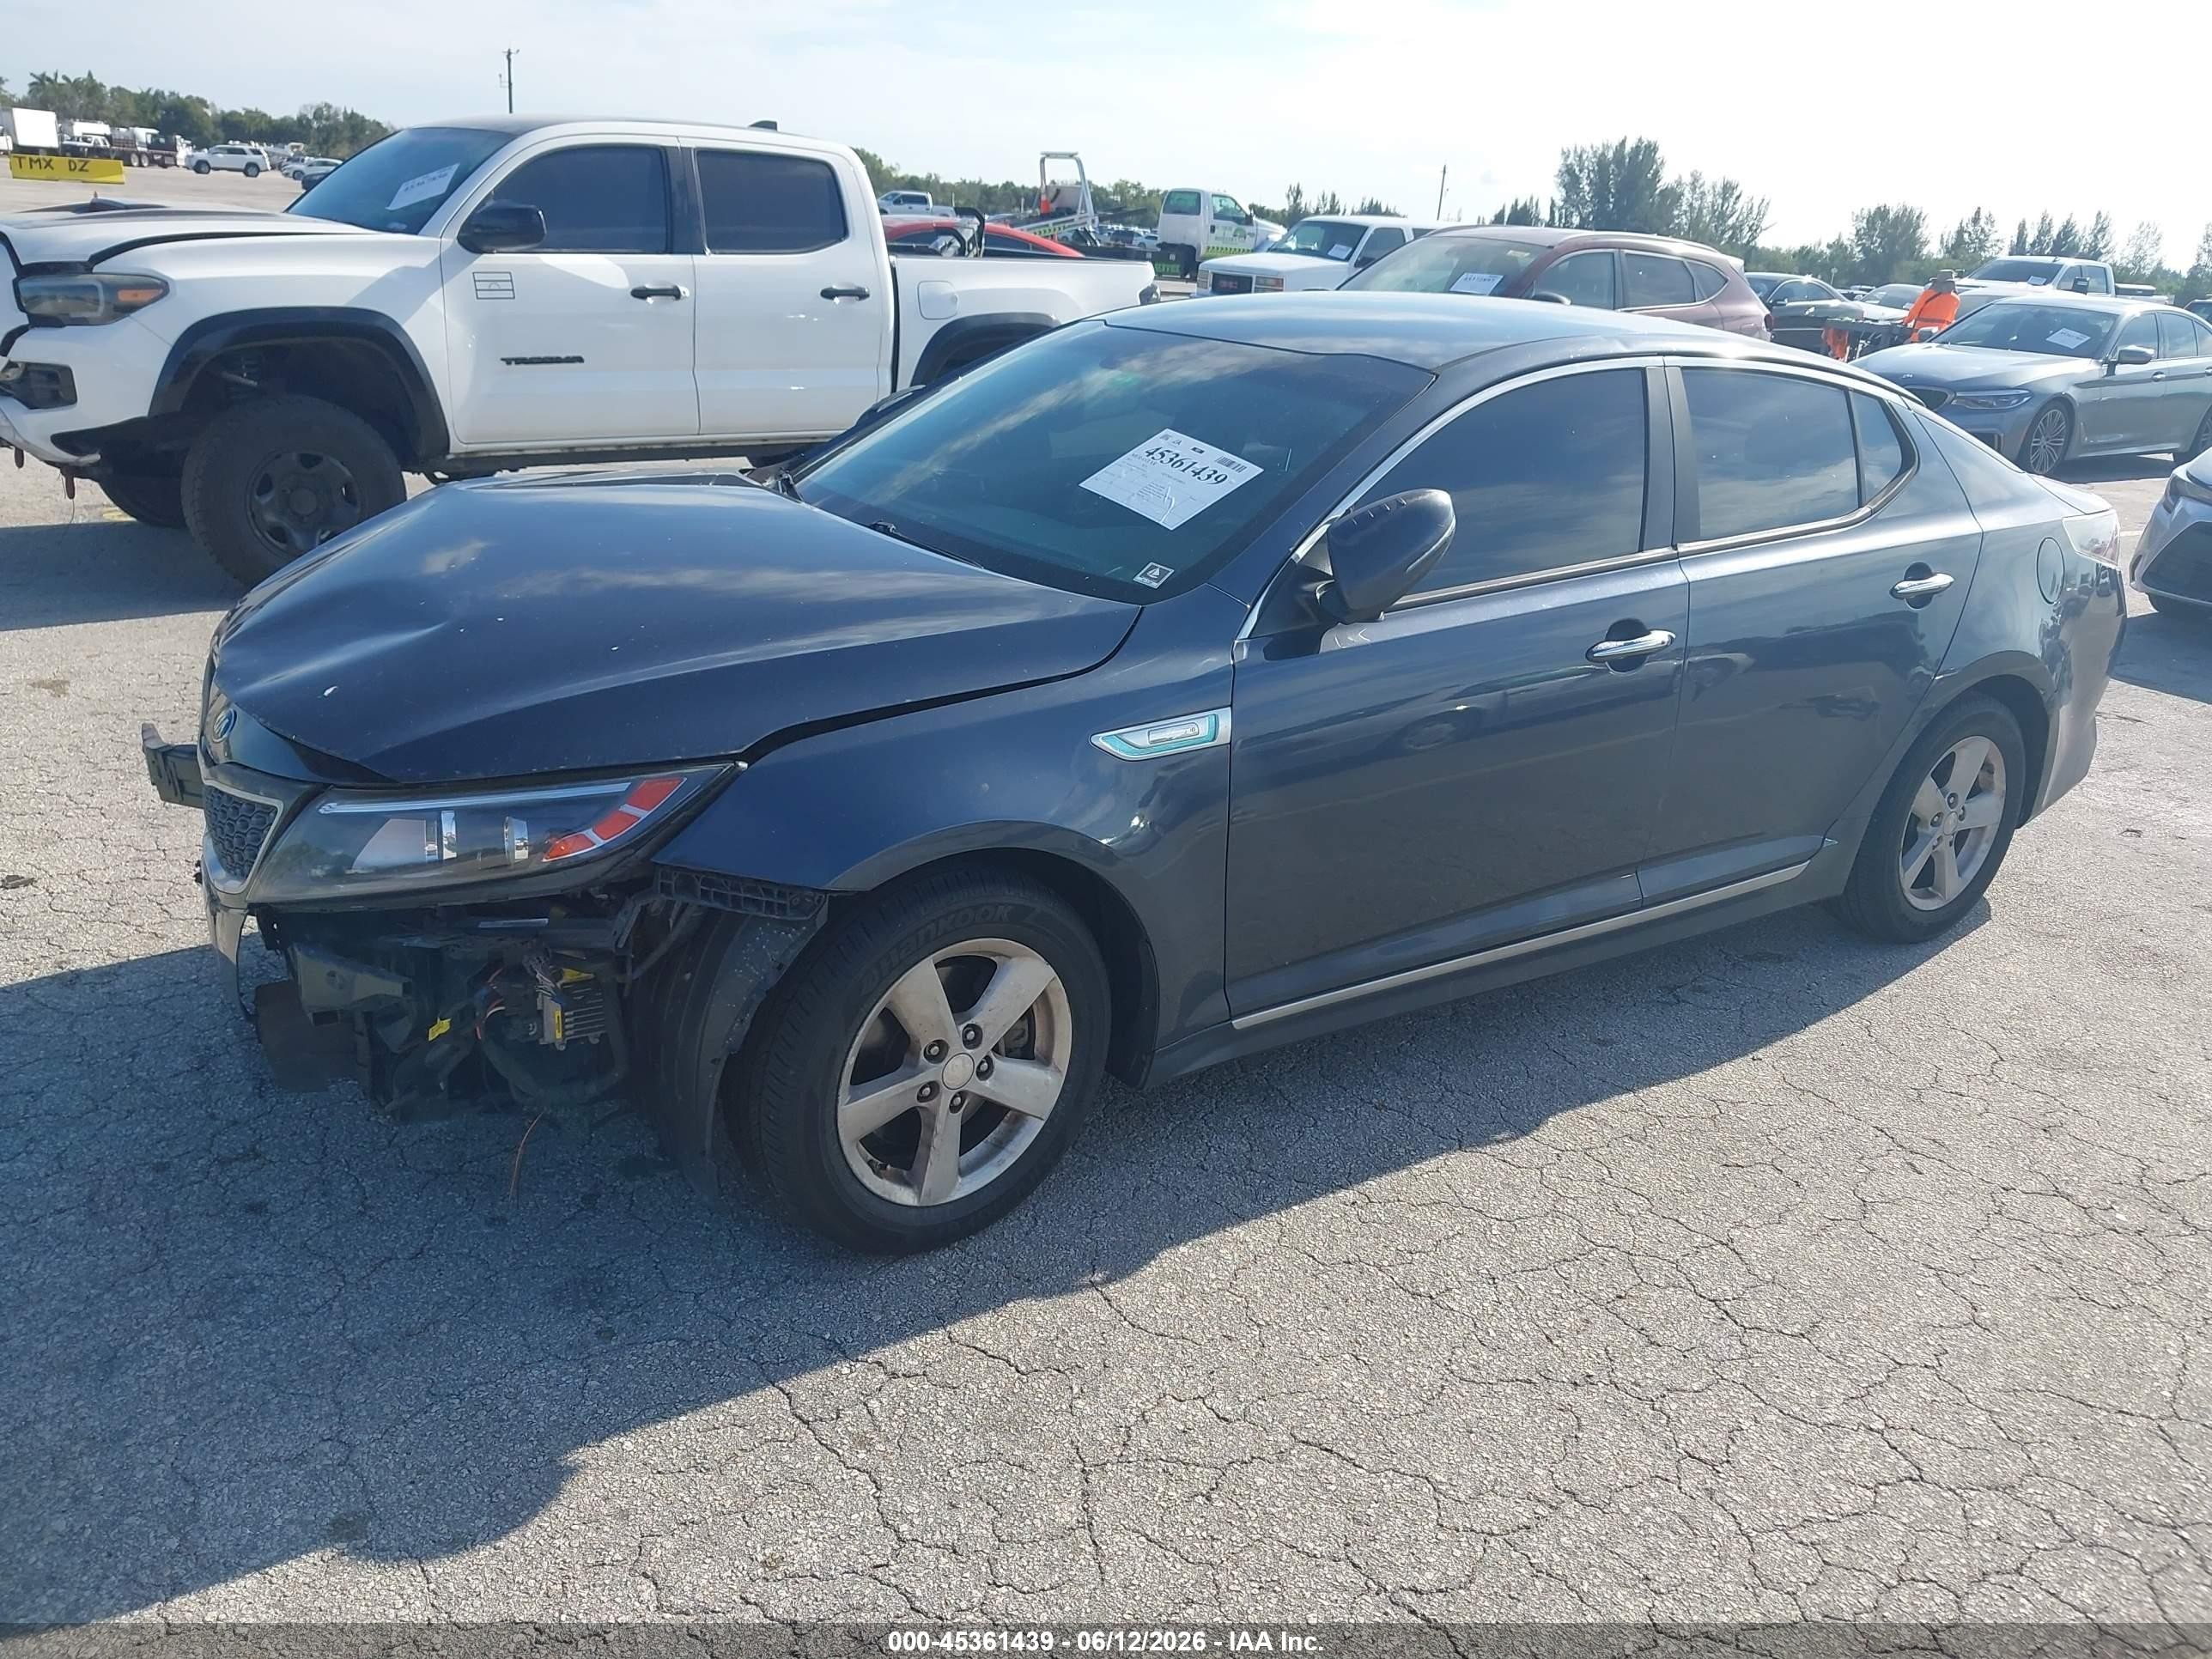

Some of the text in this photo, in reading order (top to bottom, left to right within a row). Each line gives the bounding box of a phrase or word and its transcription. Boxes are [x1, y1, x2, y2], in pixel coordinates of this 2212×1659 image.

[13, 155, 90, 172] TMX DZ
[1145, 447, 1228, 485] 45361439
